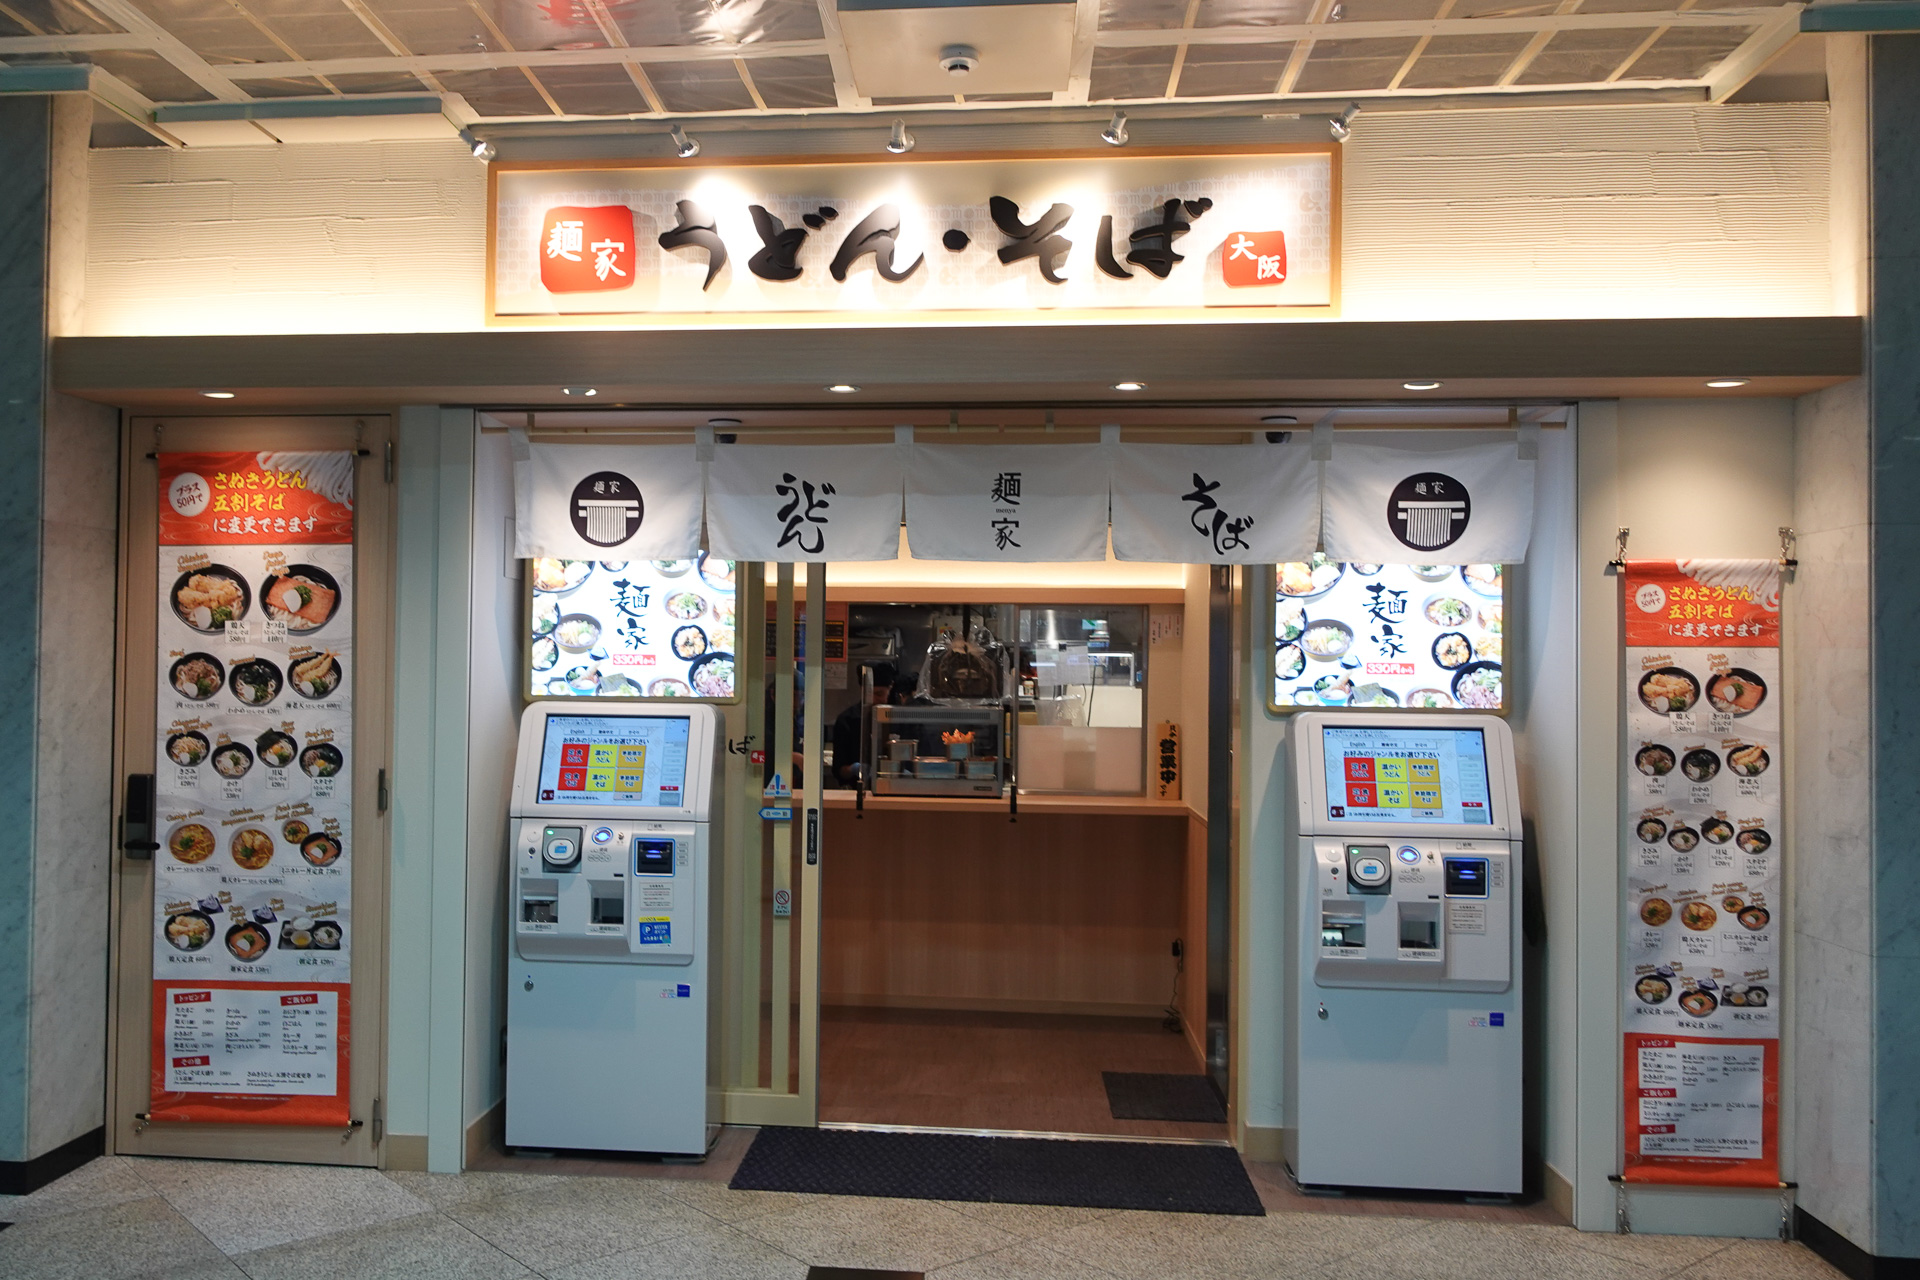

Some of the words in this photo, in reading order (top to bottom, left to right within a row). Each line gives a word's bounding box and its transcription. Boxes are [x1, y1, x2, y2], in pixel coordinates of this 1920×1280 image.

[545, 219, 627, 283] 麺家
[1228, 233, 1286, 282] 大阪
[214, 470, 308, 490] さぬきうどん
[593, 480, 621, 495] 麺家
[1414, 481, 1445, 496] 麺家
[176, 494, 204, 509] 50円で
[213, 492, 287, 513] 五割そば
[775, 472, 837, 553] うどん
[1181, 472, 1254, 555] そば
[213, 516, 318, 535] に変更できます
[1668, 584, 1755, 602] さぬきうどん
[610, 578, 652, 651] 麺家
[1363, 582, 1408, 658] 麺家
[1668, 603, 1735, 620] 五割そば
[1668, 622, 1764, 638] に変更できます
[562, 736, 651, 746] お好みのジャンルをお選び下さい
[1343, 750, 1441, 758] お好みのジャンルをお選び下さい
